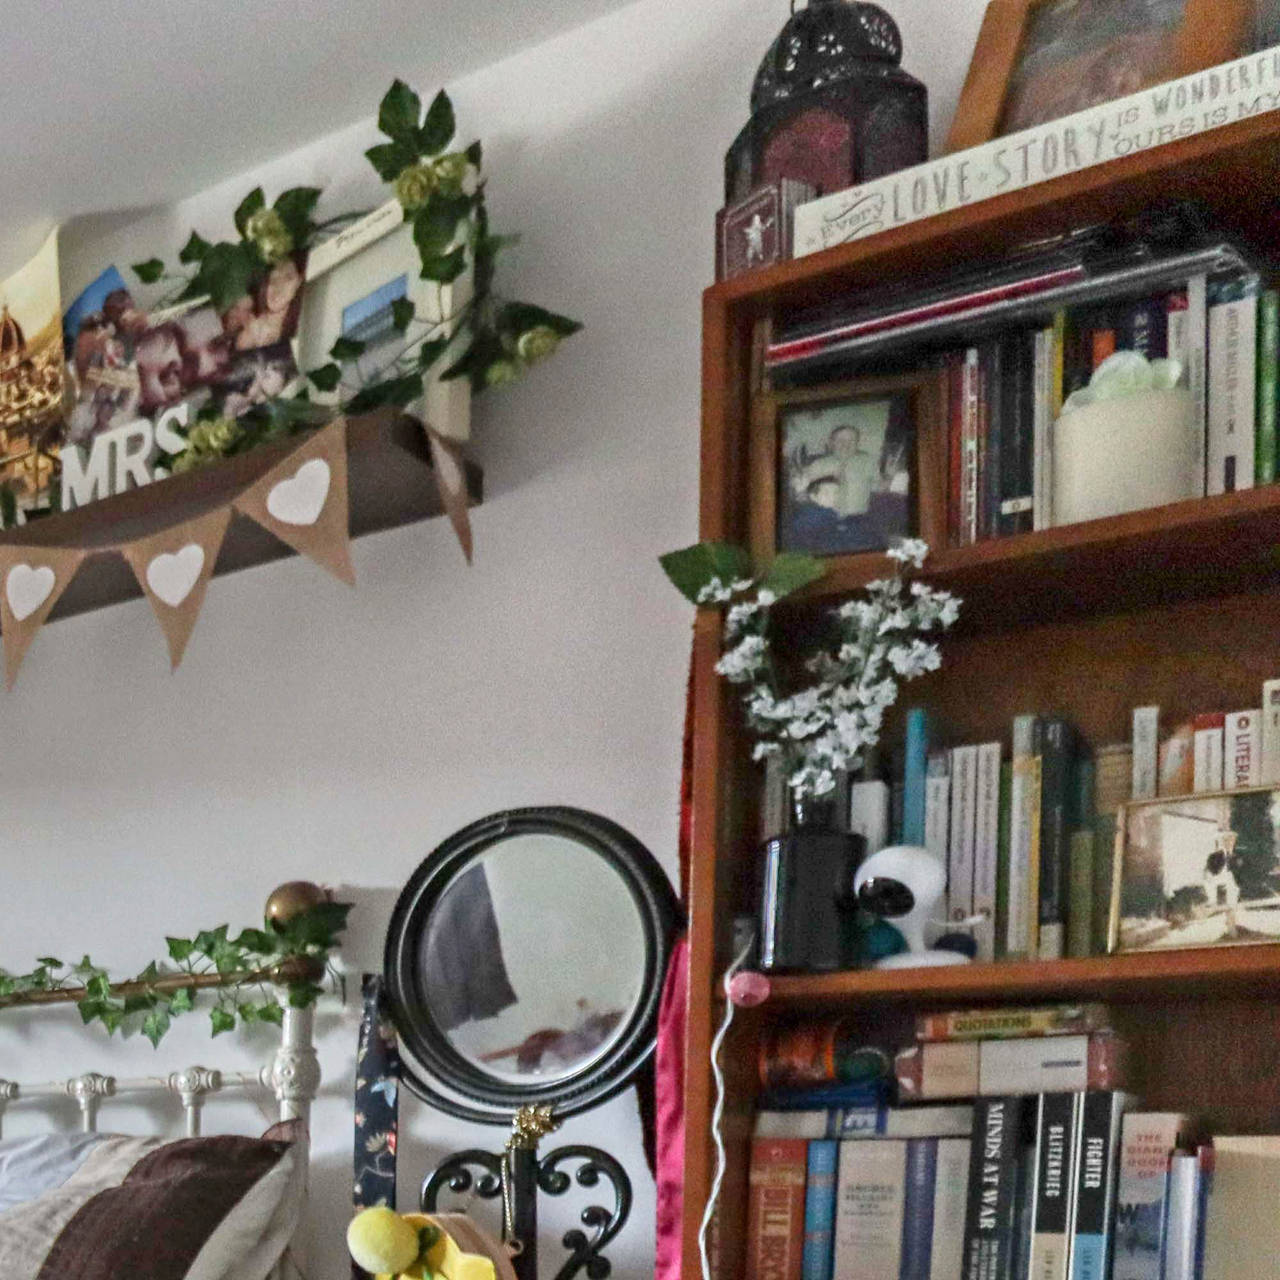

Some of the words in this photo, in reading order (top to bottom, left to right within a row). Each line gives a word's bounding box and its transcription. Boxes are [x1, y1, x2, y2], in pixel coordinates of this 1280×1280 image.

[893, 160, 972, 222] LOVE
[993, 118, 1107, 189] STORY
[60, 401, 189, 513] MRS
[984, 1102, 1005, 1159] MINDS
[982, 1164, 1000, 1187] AT
[1044, 1125, 1065, 1199] BLITZKRIEG
[1083, 1136, 1105, 1190] FIGHTER
[978, 1189, 999, 1230] WAR
